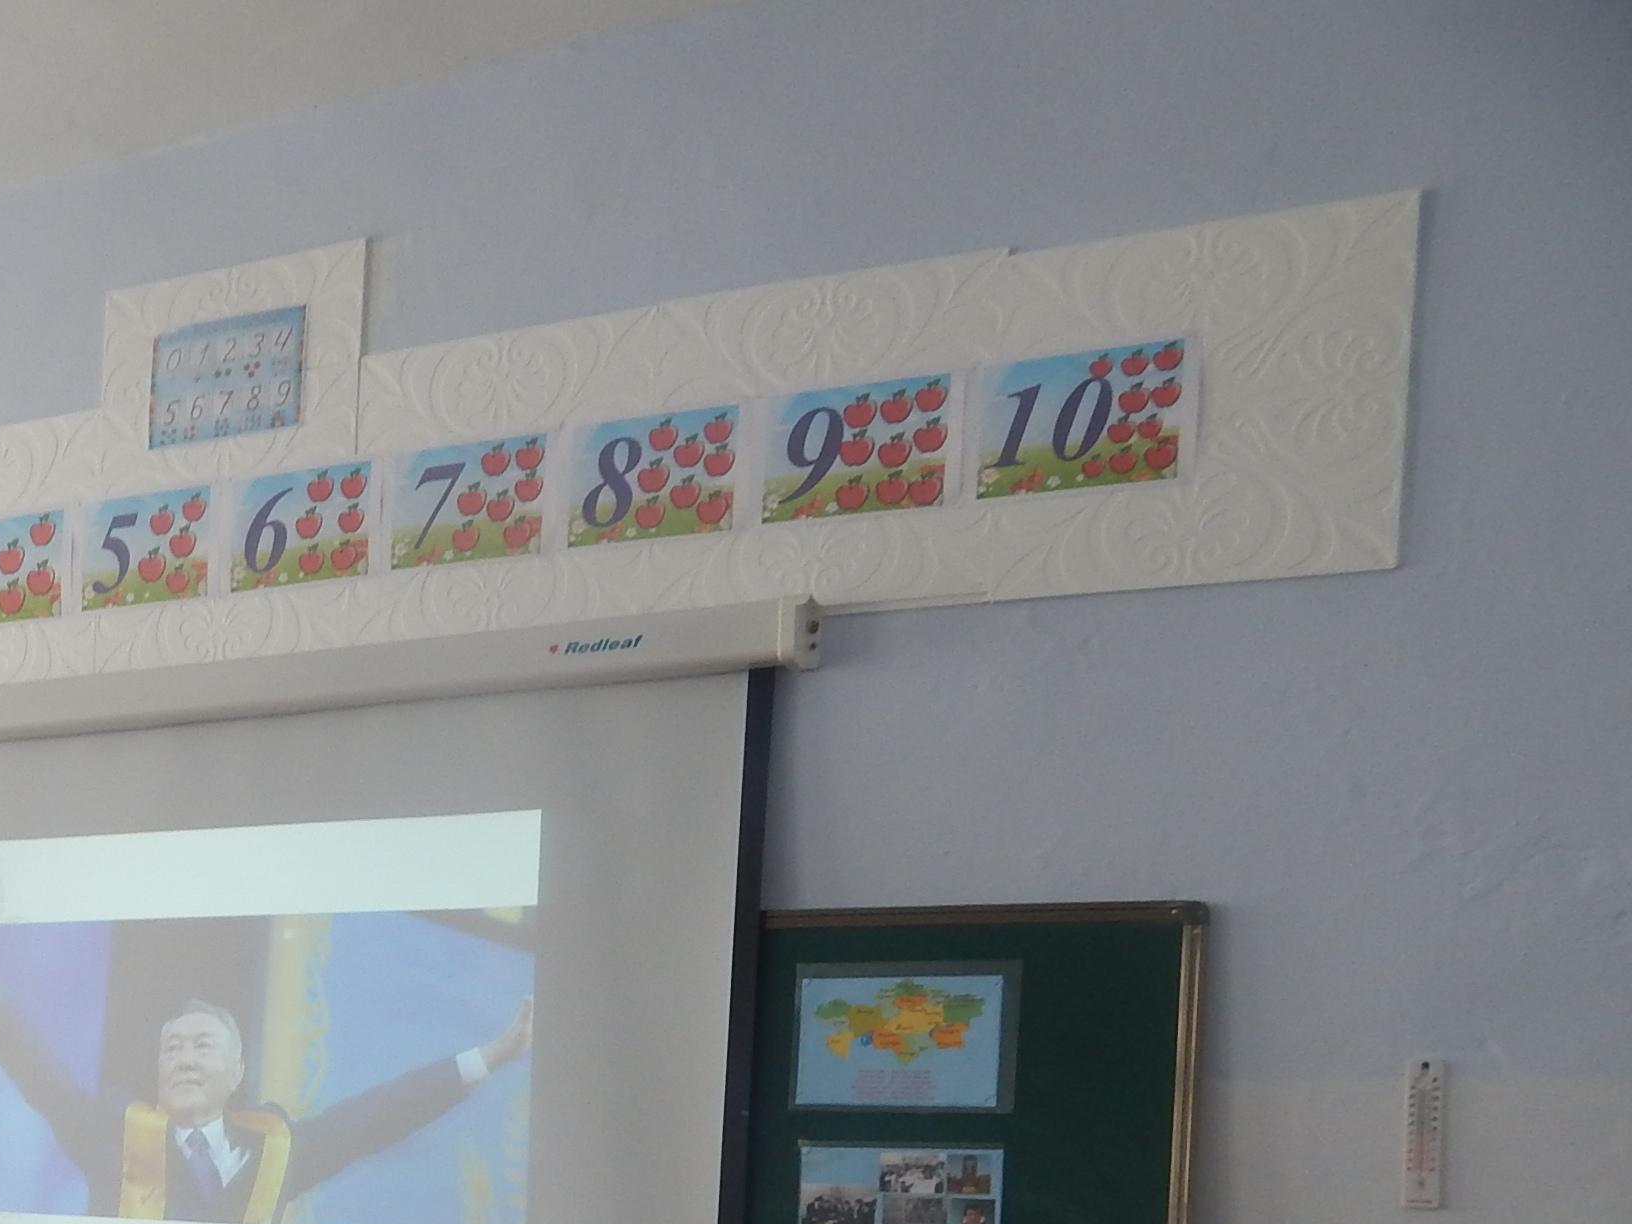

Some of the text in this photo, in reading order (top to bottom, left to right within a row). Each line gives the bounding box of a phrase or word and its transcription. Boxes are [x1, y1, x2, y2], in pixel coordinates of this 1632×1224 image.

[166, 327, 293, 371] 0 1 2 3 4
[163, 379, 292, 425] 5 6 7 8 9
[92, 511, 138, 594] 5
[243, 487, 294, 574] 6
[413, 462, 466, 550] 7
[580, 436, 643, 529] 8
[777, 406, 846, 505] 9
[986, 376, 1115, 469] 10
[564, 633, 644, 656] Redleaf
